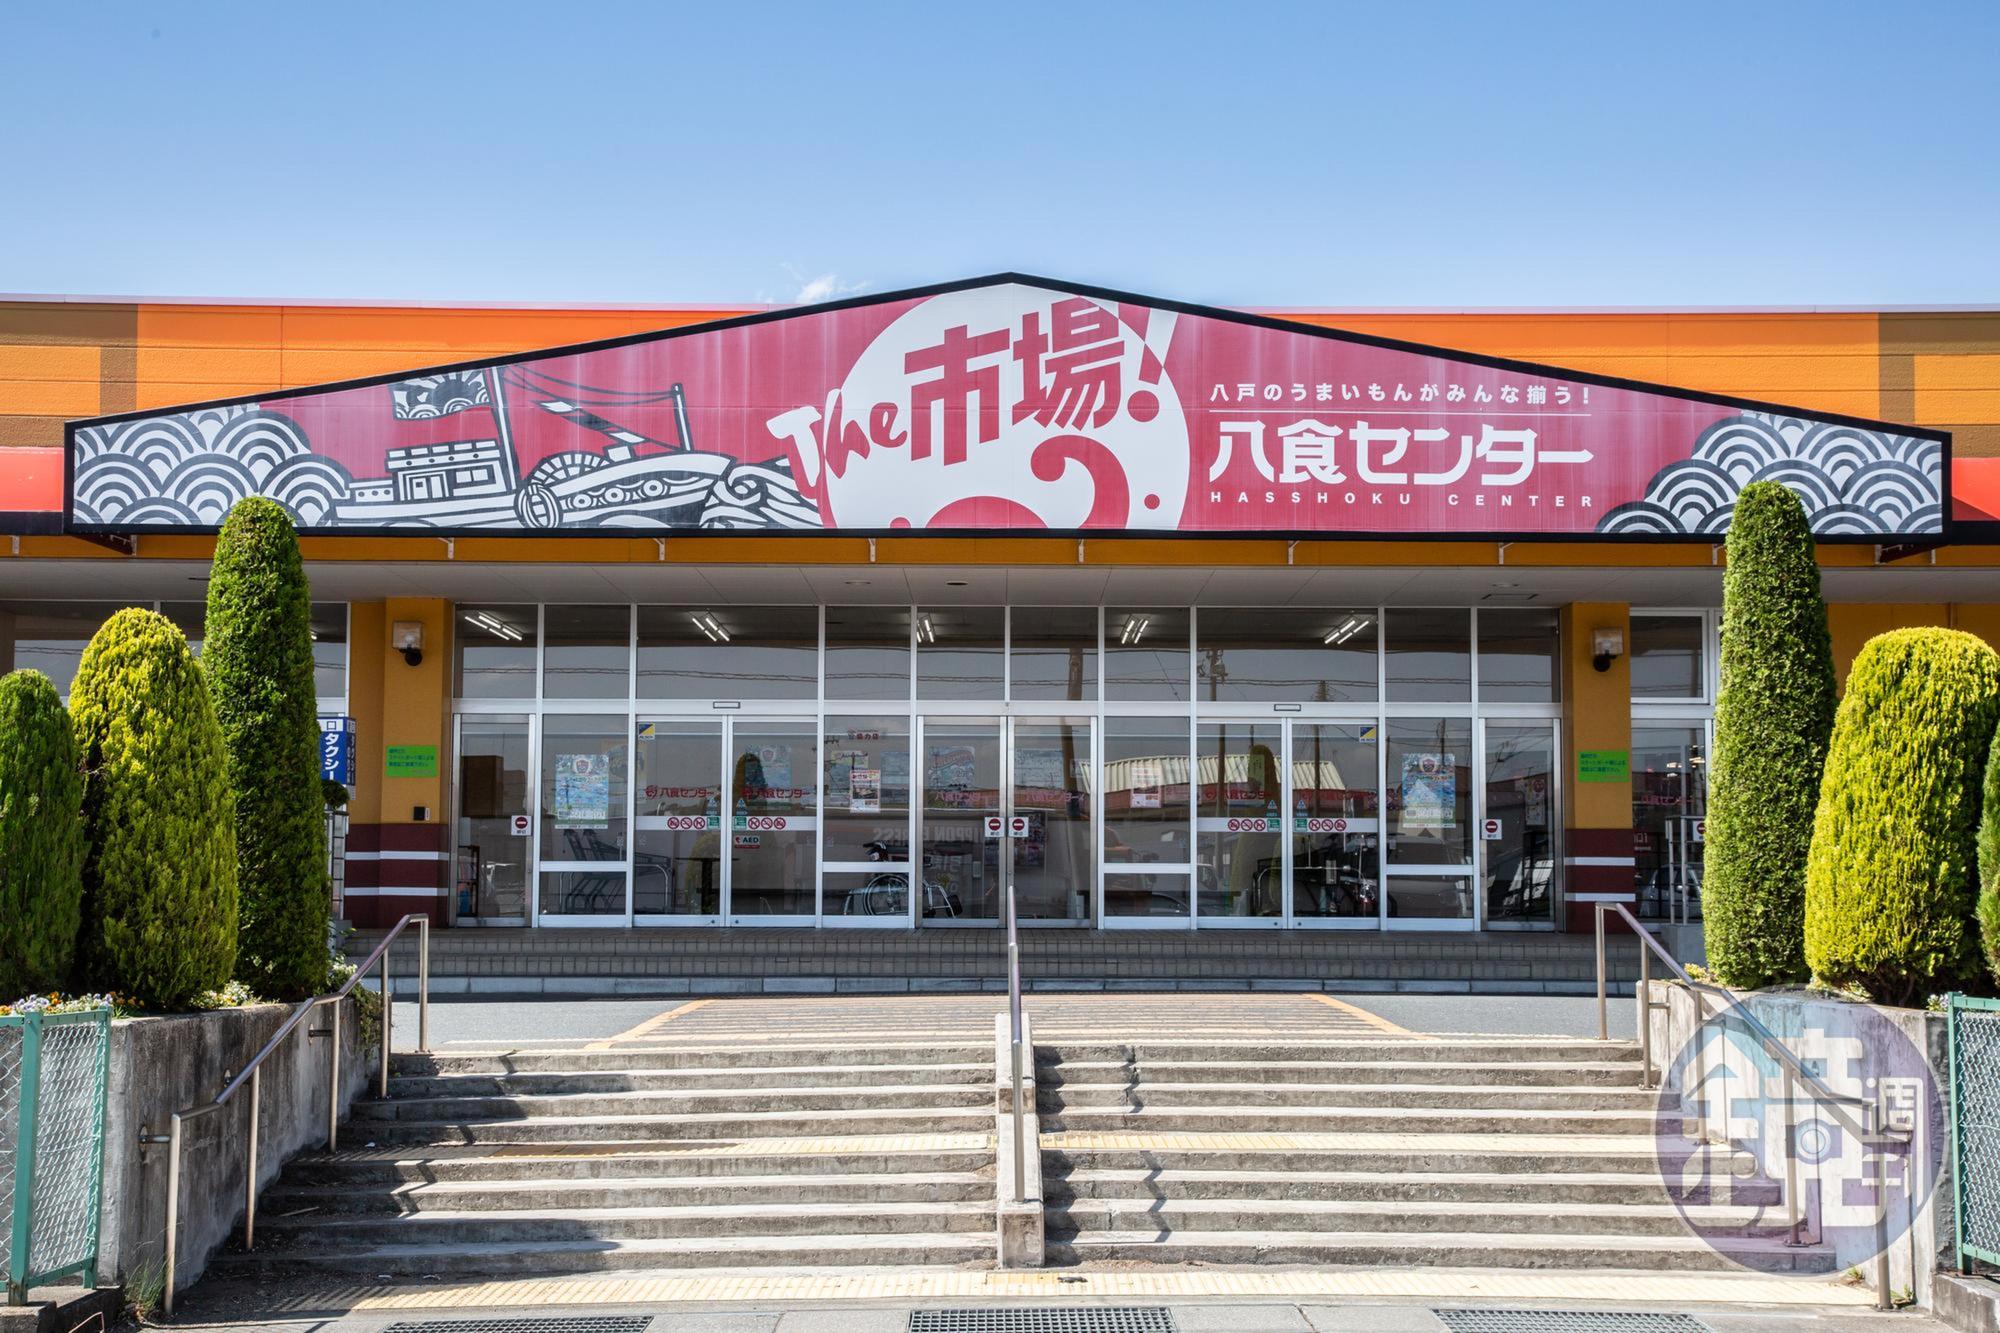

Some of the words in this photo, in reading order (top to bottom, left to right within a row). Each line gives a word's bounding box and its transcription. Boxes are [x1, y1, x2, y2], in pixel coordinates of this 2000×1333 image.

[766, 388, 908, 487] The
[1209, 419, 1594, 486] 八食センター
[1210, 492, 1411, 505] HASSHOKU
[1448, 494, 1592, 507] CENTER
[325, 732, 340, 781] タクシー
[742, 836, 759, 844] AED
